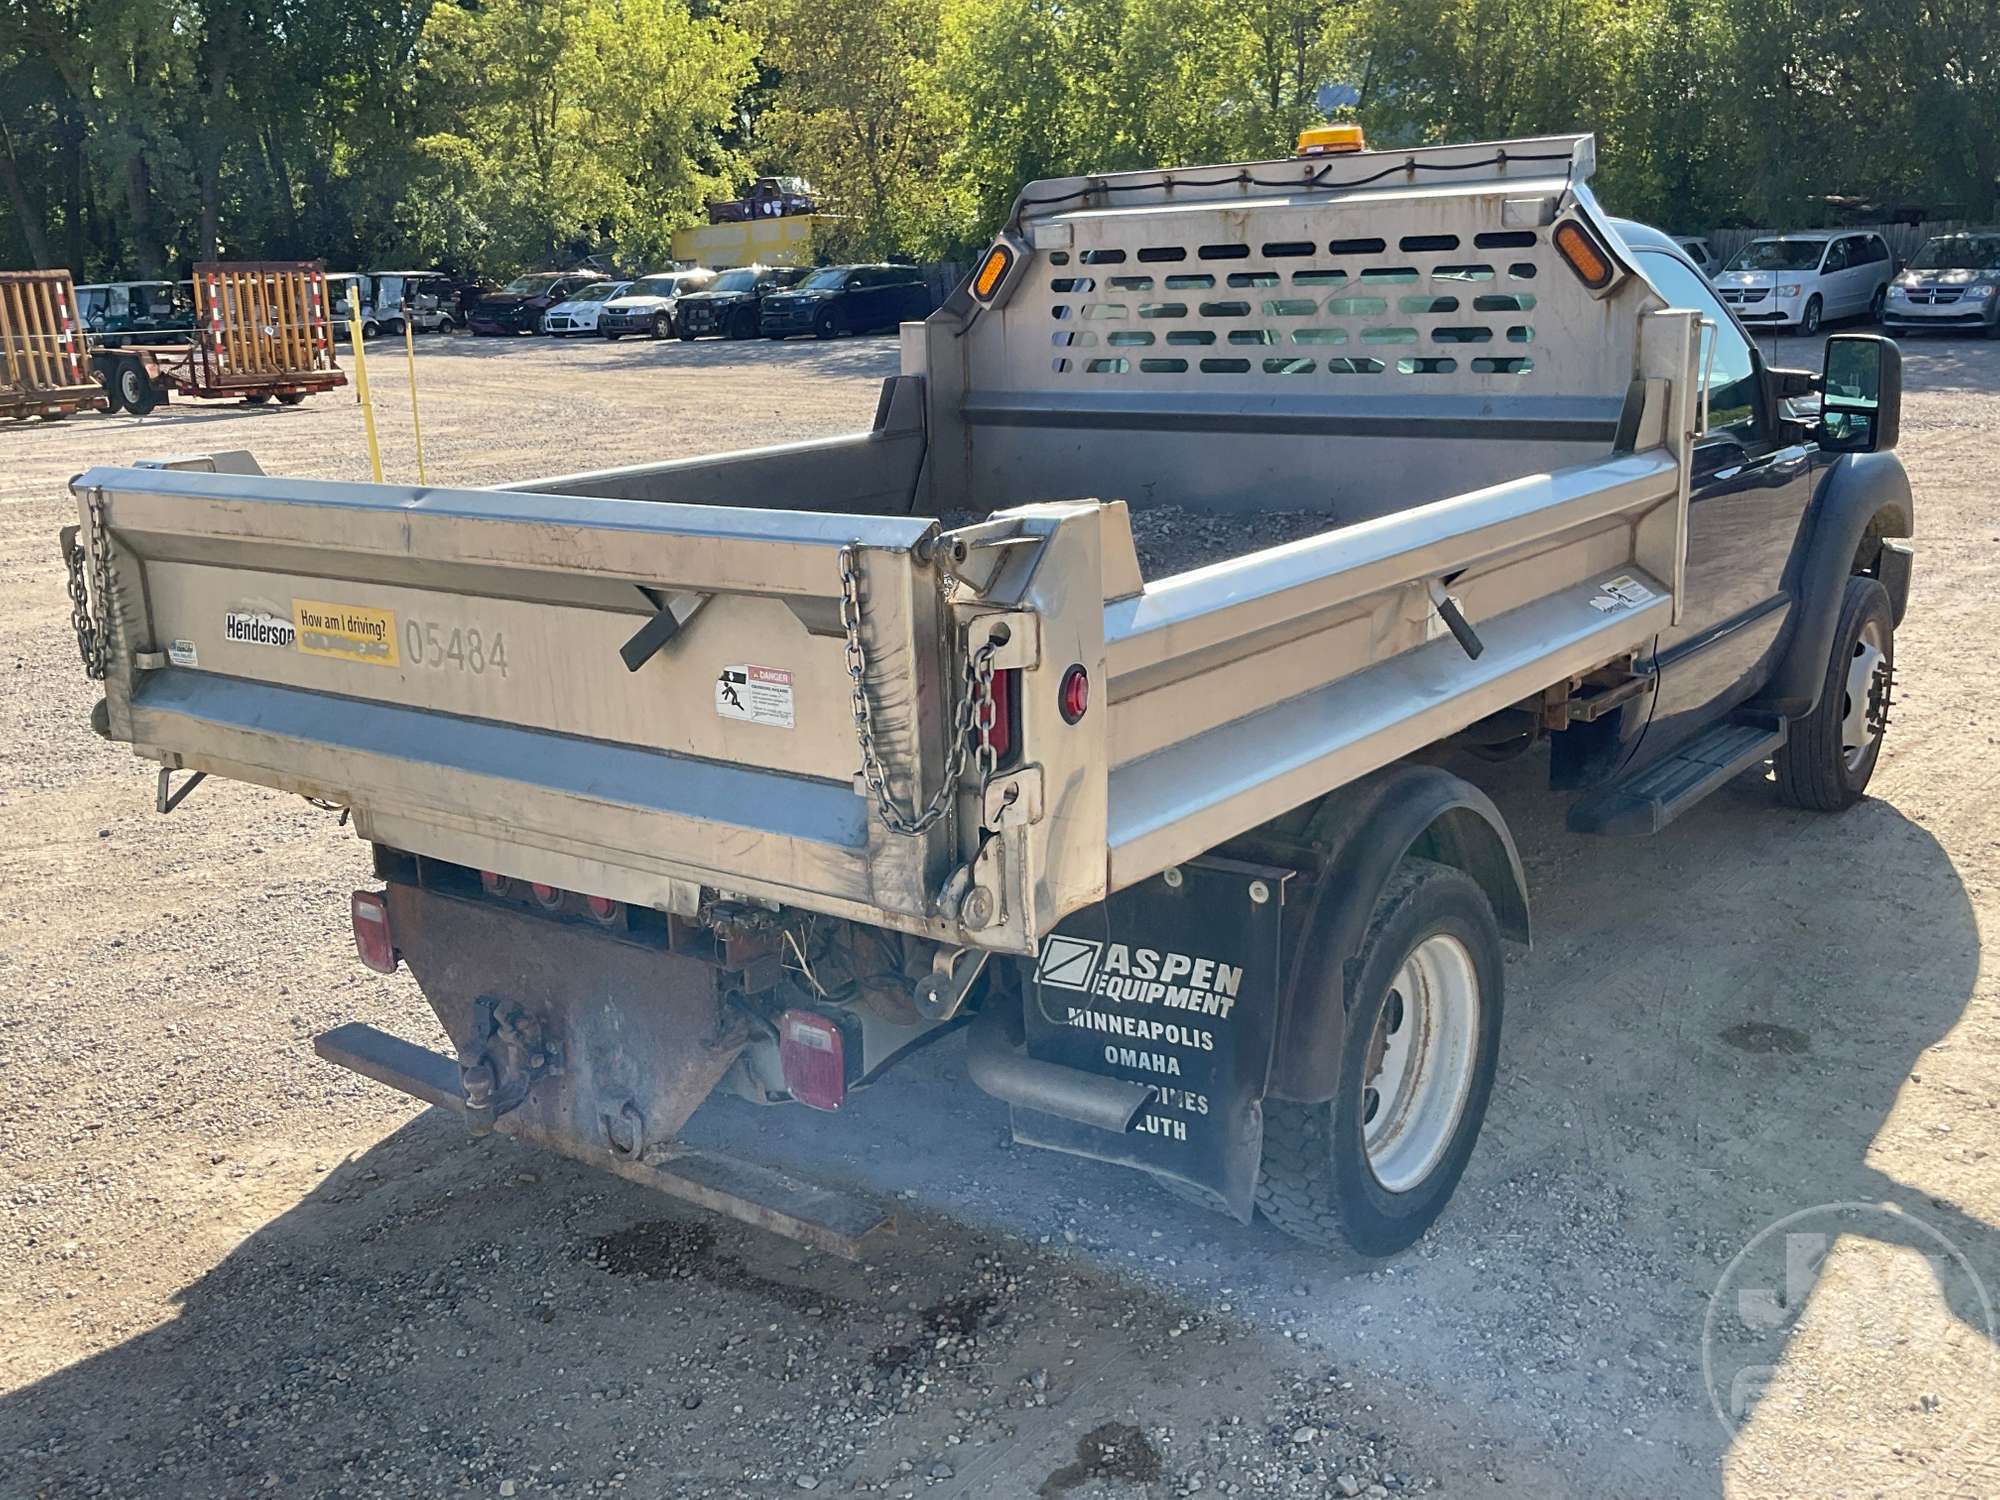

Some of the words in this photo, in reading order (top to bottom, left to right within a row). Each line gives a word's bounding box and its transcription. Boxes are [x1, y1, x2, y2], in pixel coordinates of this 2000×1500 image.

[227, 615, 296, 646] Henderson
[301, 609, 322, 628] How
[324, 617, 340, 631] am
[342, 615, 346, 631] I
[347, 616, 386, 641] driving?
[406, 619, 508, 678] 05484
[759, 670, 788, 684] DANGER
[1099, 943, 1243, 997] ASPEN
[1091, 973, 1236, 1019] EQUIPMENT
[1067, 1007, 1215, 1051] MINNEAPOLIS
[1104, 1045, 1181, 1076] OMAHA
